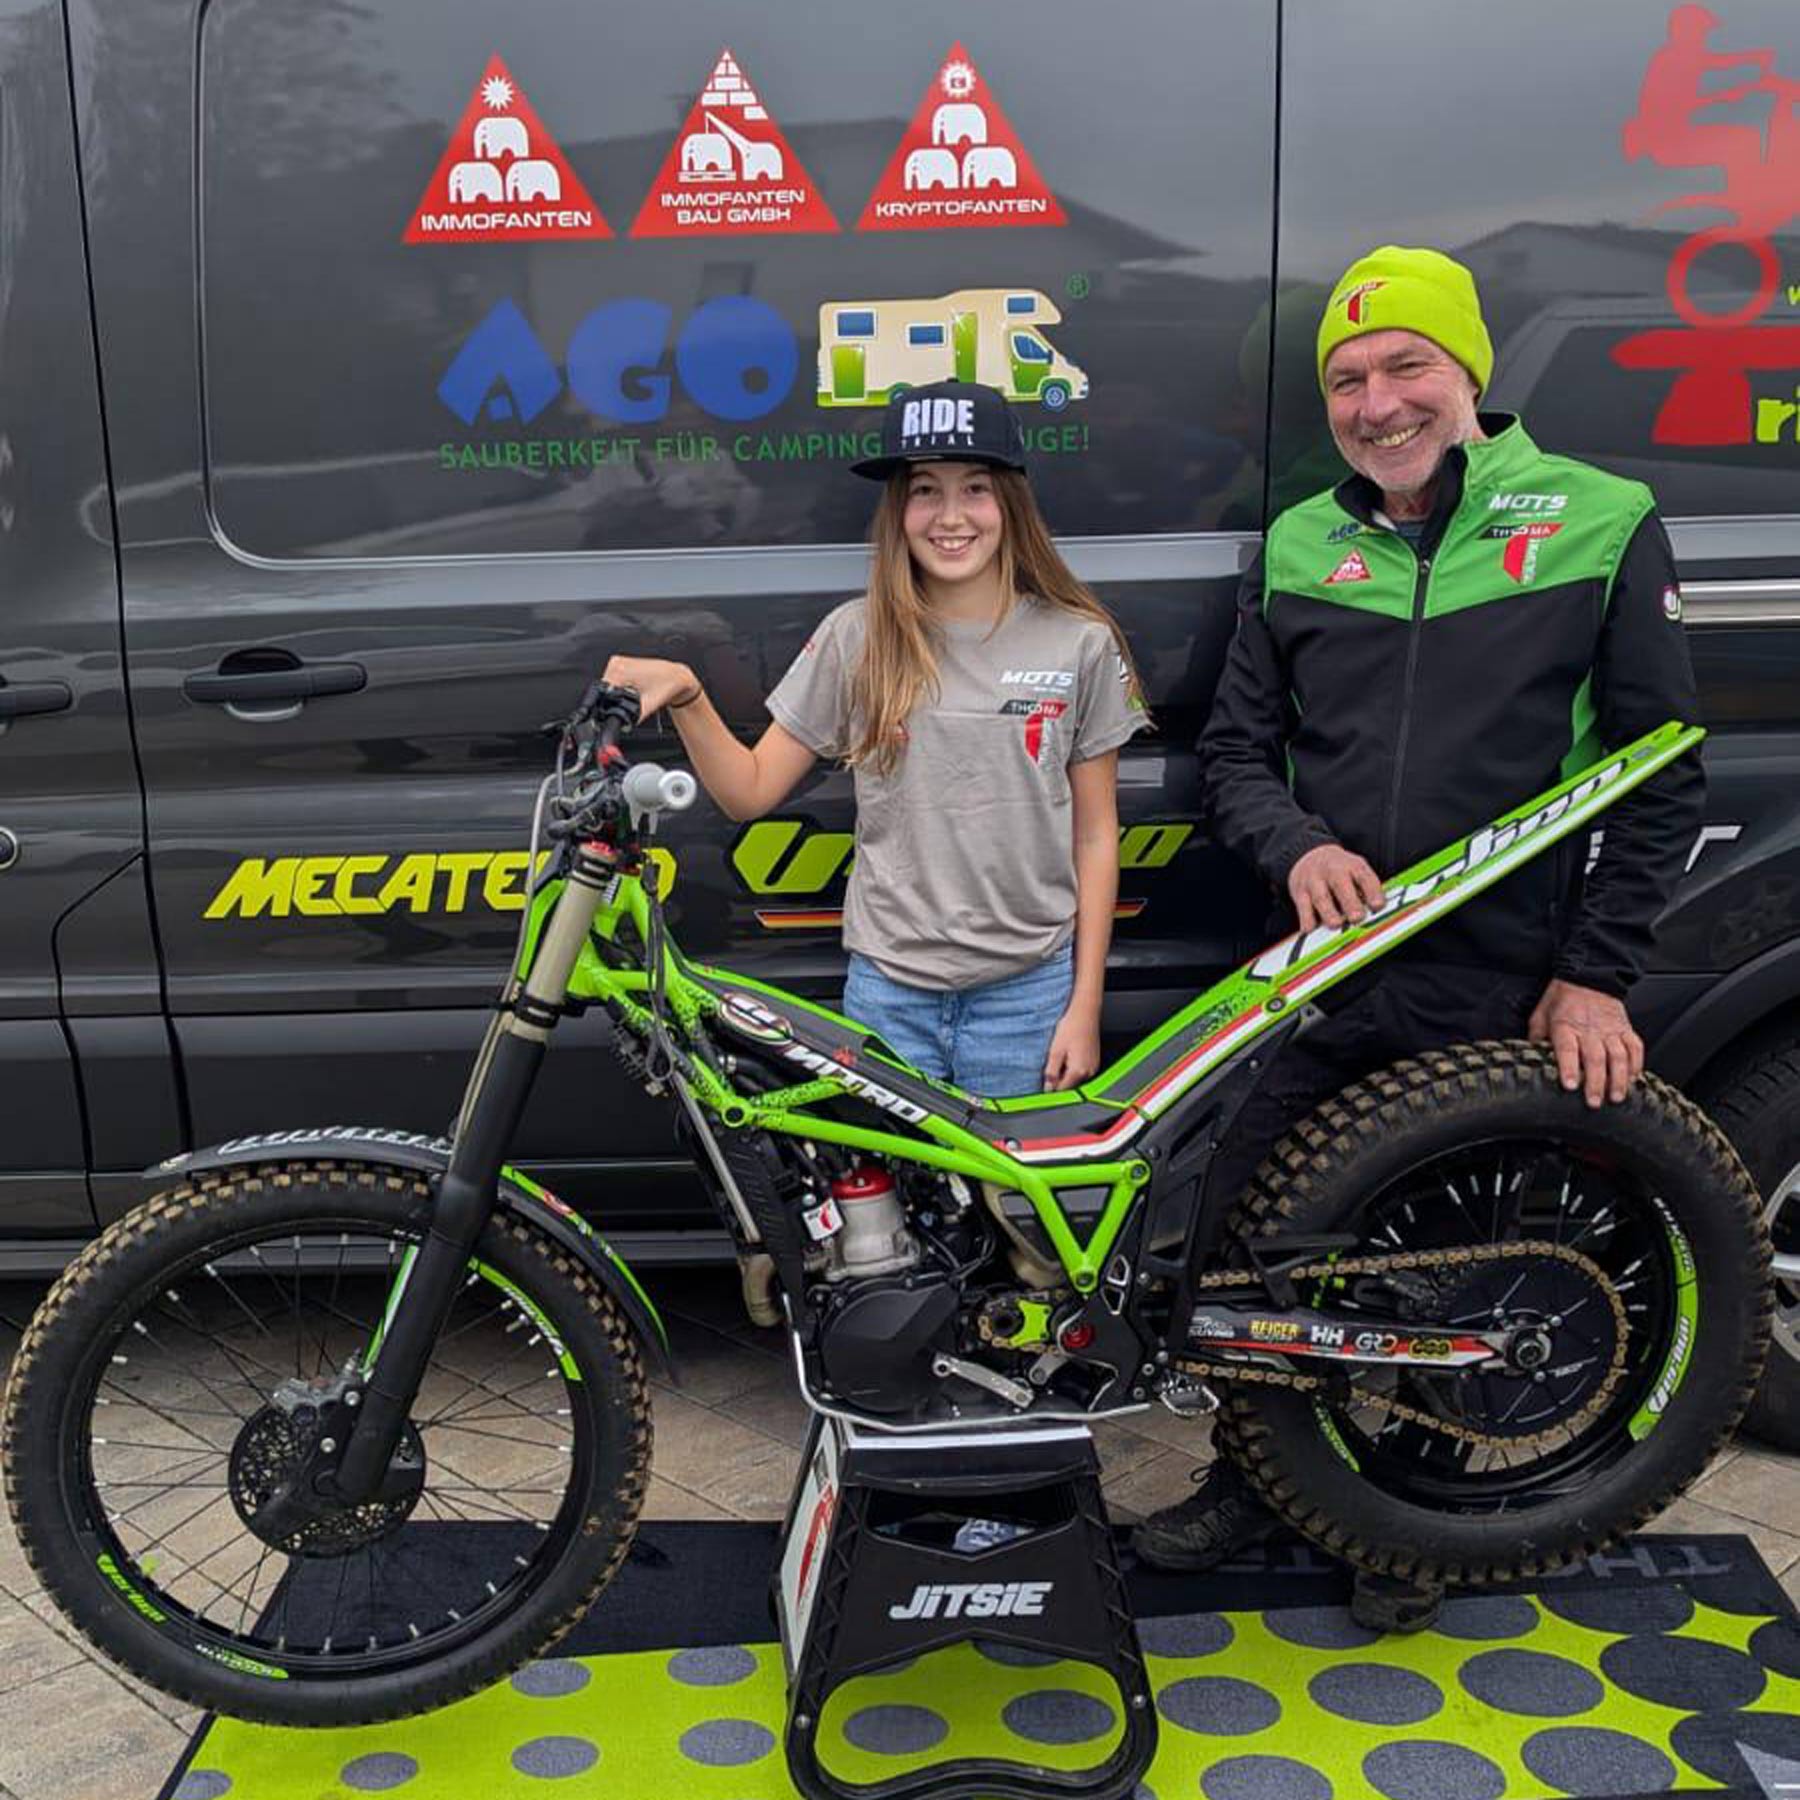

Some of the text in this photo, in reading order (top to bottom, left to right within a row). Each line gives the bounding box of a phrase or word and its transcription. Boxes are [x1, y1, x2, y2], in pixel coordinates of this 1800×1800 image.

[660, 188, 806, 208] IMMOFANTEN
[875, 197, 1047, 217] KRYPTOFANTEN
[420, 210, 593, 231] IMMOFANTEN
[676, 206, 792, 225] BAU GMBH
[437, 293, 799, 427] AGO
[902, 398, 975, 438] RIDE
[439, 438, 641, 469] SAUBERKEIT
[655, 431, 722, 462] FÜR
[1000, 671, 1073, 687] MOTS
[1311, 1325, 1345, 1345] HH
